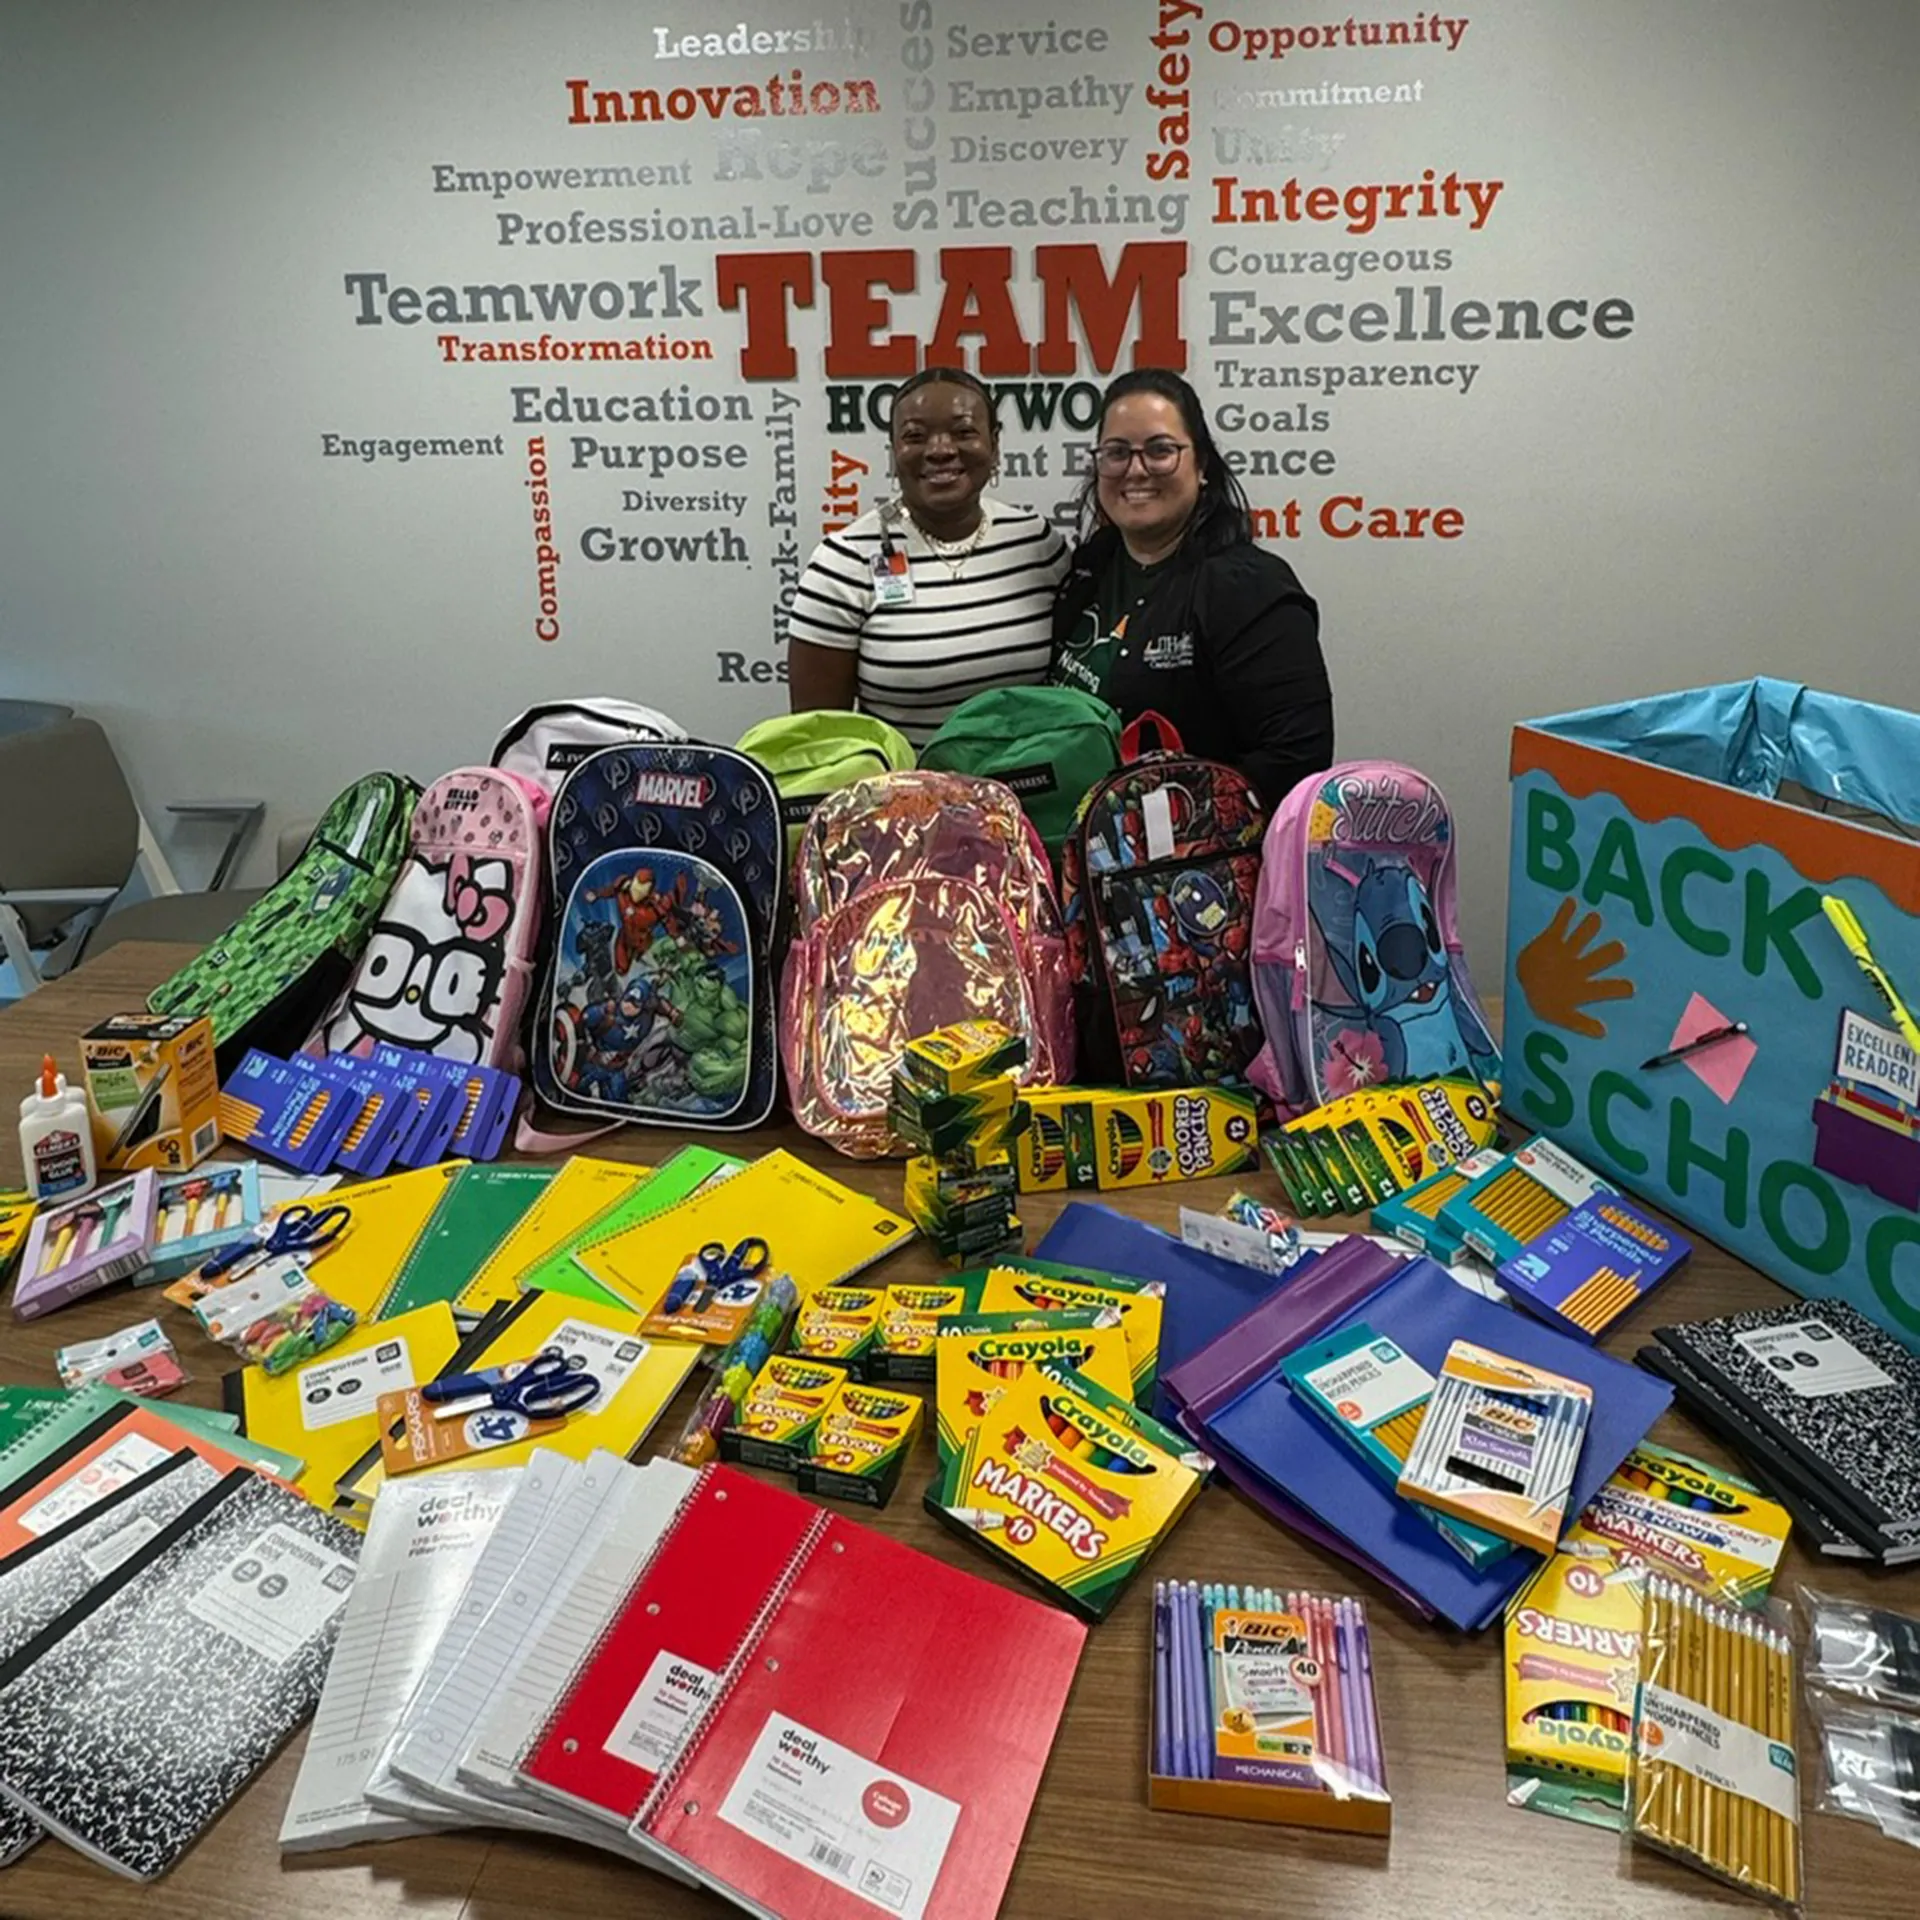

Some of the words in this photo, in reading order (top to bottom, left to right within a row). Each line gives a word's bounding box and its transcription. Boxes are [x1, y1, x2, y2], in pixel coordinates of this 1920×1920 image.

[947, 20, 1109, 58] Service
[1208, 12, 1469, 60] Opportunity
[566, 69, 881, 123] Innovation
[947, 75, 1135, 119] Empathy
[1146, 0, 1203, 181] Safety
[950, 135, 1129, 165] Discovery
[432, 158, 693, 198] Empowerment
[946, 185, 1190, 235] Teaching
[1212, 169, 1504, 234] Integrity
[497, 204, 874, 246] Professional-Love
[1209, 246, 1453, 278] Courageous
[344, 265, 703, 326] Teamwork
[715, 247, 1189, 380] TEAM
[1209, 286, 1635, 346] Excellence
[438, 334, 713, 363] Transformation
[1214, 360, 1479, 394] Transparency
[511, 386, 752, 424] Education
[1215, 403, 1330, 434] Goals
[322, 433, 504, 463] Engagement
[571, 436, 748, 478] Purpose
[622, 489, 747, 516] Diversity
[1319, 497, 1465, 540] Care
[525, 436, 561, 642] Compassion
[580, 527, 749, 562] Growth
[1057, 649, 1101, 695] Nursing
[447, 788, 479, 801] HELLO
[636, 773, 704, 808] MARVEL
[1334, 774, 1441, 845] Stitch
[1525, 788, 1827, 1000] BACK
[97, 1044, 126, 1057] BIC
[1847, 1023, 1919, 1067] EXCELLENT
[1844, 1045, 1917, 1094] READER!
[1432, 1086, 1477, 1155] PENCILS
[1468, 1101, 1485, 1117] 12
[1174, 1096, 1195, 1176] COLORED
[1191, 1098, 1213, 1170] PENCILS
[1229, 1119, 1246, 1138] 12
[1029, 1117, 1042, 1178] Crayola
[1105, 1117, 1118, 1176] Crayola
[1078, 1163, 1093, 1183] 12
[1379, 1178, 1396, 1198] 12
[1347, 1183, 1363, 1206] 12
[818, 1289, 871, 1300] Crayola
[898, 1287, 951, 1299] Crayola
[1024, 1279, 1120, 1307] Crayola
[802, 1325, 862, 1340] CRAYONS
[884, 1325, 938, 1338] CRAYON
[978, 1335, 1083, 1363] Crayola
[777, 1361, 831, 1379] Crayola
[745, 1403, 808, 1425] CRAYONS
[849, 1390, 906, 1408] Crayola
[404, 1390, 429, 1461] FISKARS
[1051, 1394, 1149, 1467] Crayola
[1485, 1407, 1534, 1428] BIC
[819, 1432, 885, 1457] CRAYONS
[417, 1503, 501, 1529] worthy
[418, 1491, 473, 1514] deal
[973, 1458, 1109, 1560] MARKERS
[1600, 1497, 1648, 1520] VOTE
[1009, 1521, 1034, 1543] 10
[1593, 1508, 1707, 1570] MARKERS
[1714, 1522, 1773, 1549] Color?
[1567, 1572, 1600, 1595] 10
[1242, 1621, 1290, 1638] BIC
[1517, 1608, 1640, 1658] ARKERS
[669, 1664, 704, 1685] deal
[1237, 1664, 1288, 1679] Smooth
[1295, 1662, 1318, 1677] 40
[665, 1675, 712, 1702] worth
[782, 1729, 818, 1755] deal
[1537, 1715, 1627, 1753] ayola
[1678, 1721, 1720, 1751] PENCILS
[778, 1738, 831, 1776] worthy
[1234, 1764, 1304, 1781] MECHANICAL
